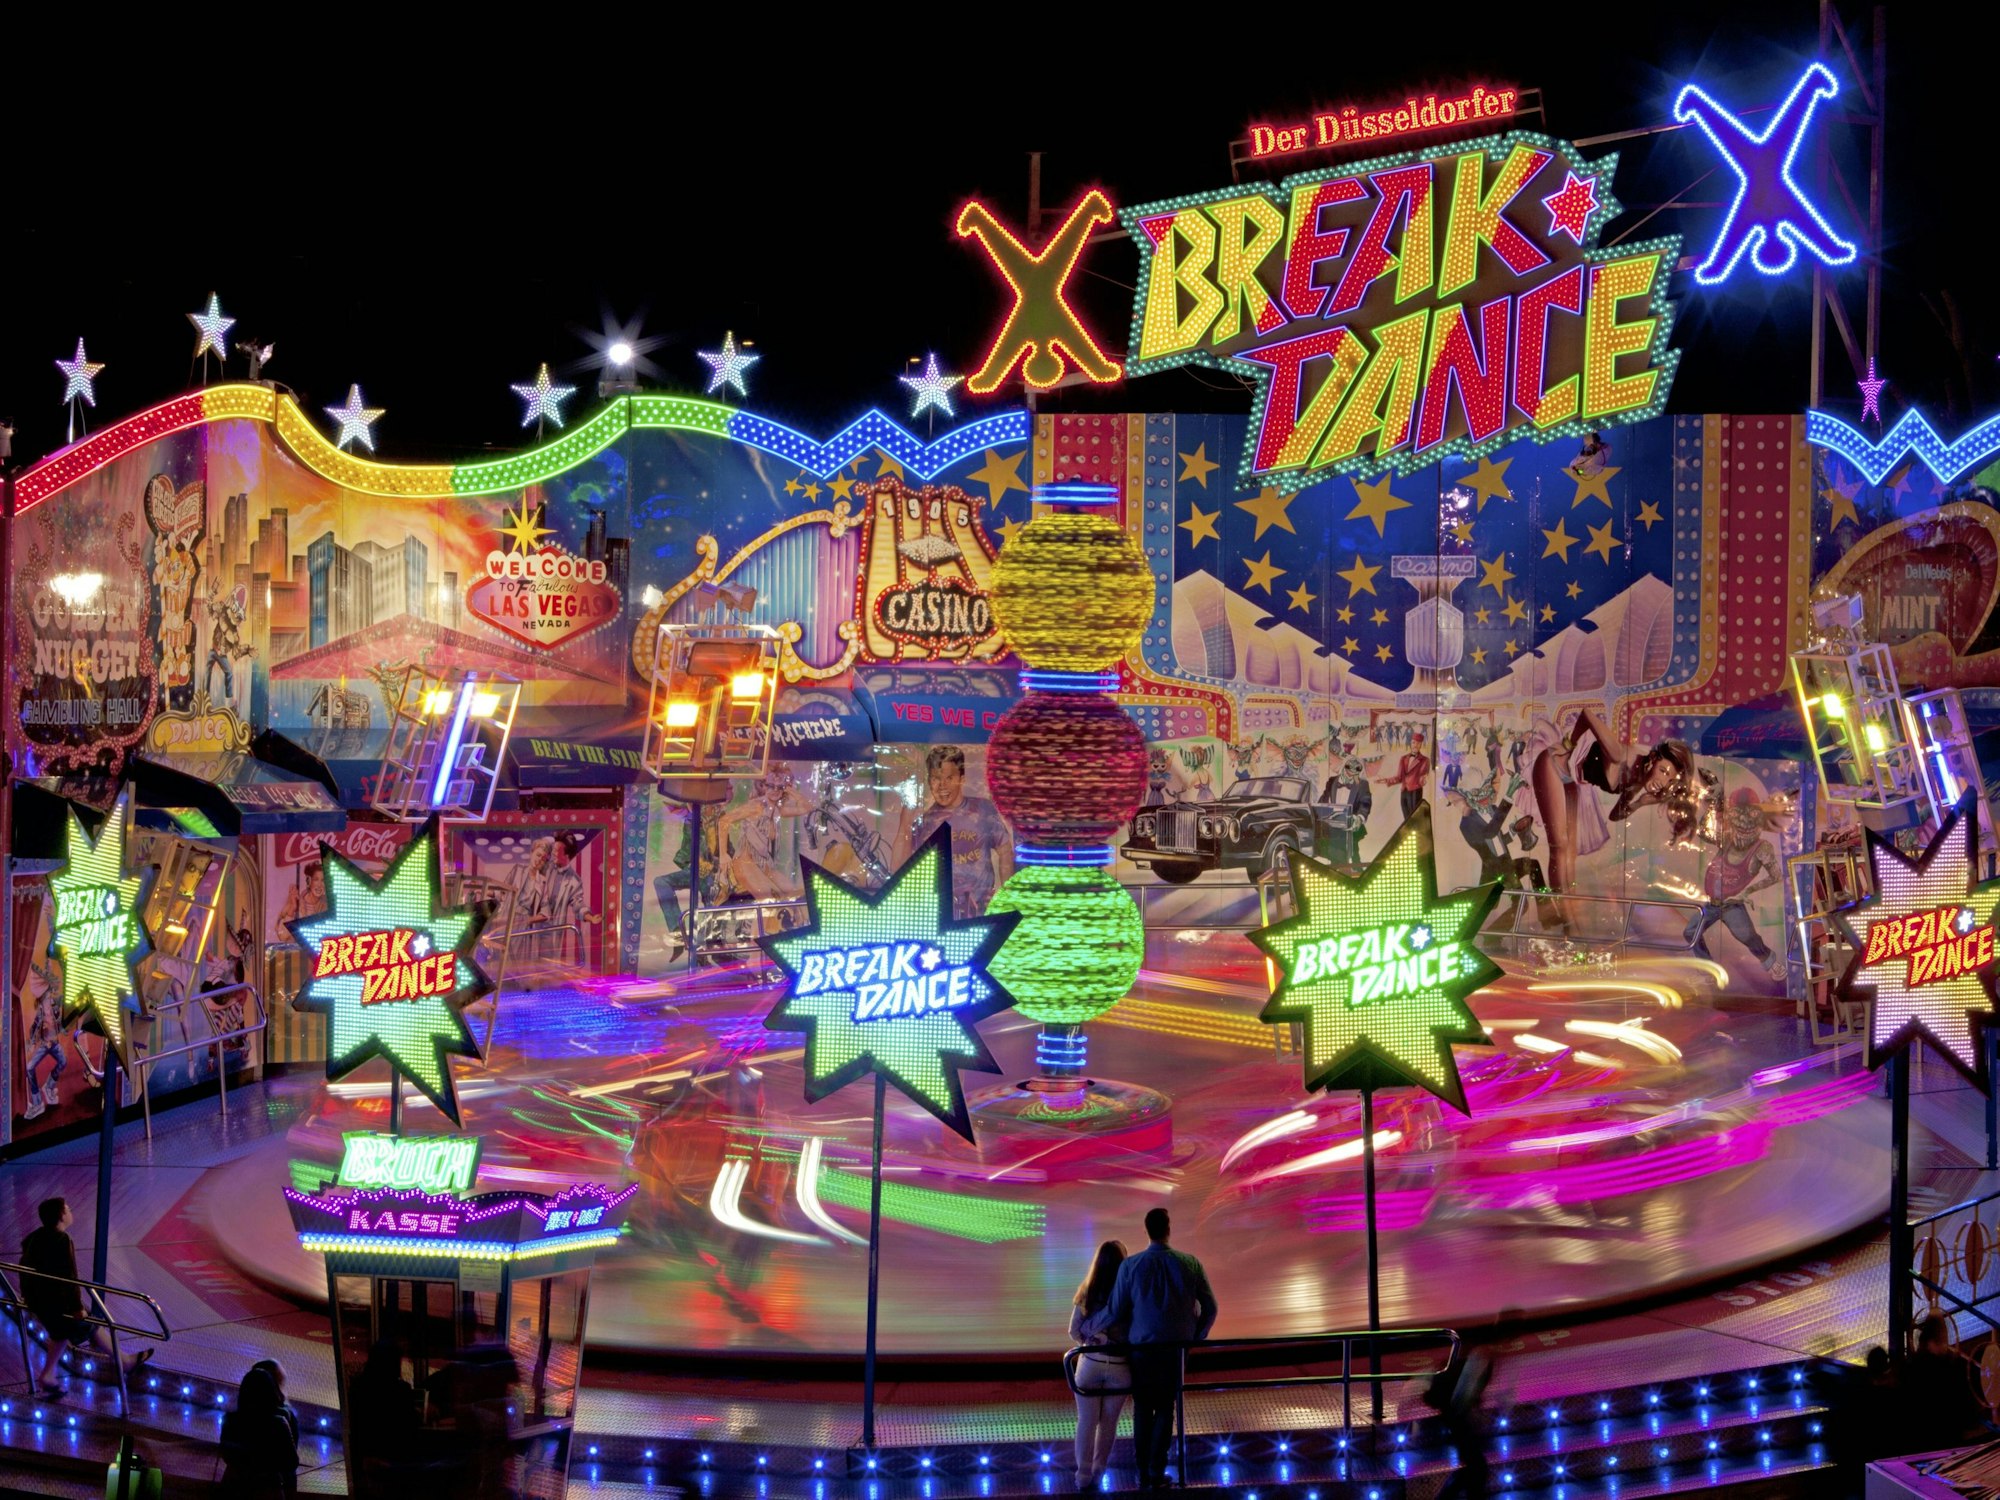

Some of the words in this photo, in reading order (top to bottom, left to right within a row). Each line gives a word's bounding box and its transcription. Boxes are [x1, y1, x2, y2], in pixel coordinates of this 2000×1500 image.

[1251, 125, 1308, 157] Der
[1316, 84, 1518, 146] Düsseldorfer
[1137, 144, 1554, 361] BREAK
[1232, 255, 1662, 475] DANCE
[490, 558, 604, 581] WELCOME
[1397, 558, 1474, 574] Casino
[489, 594, 530, 618] LAS
[538, 594, 602, 618] VEGAS
[499, 582, 515, 592] TO
[515, 579, 580, 598] Fabulous
[32, 590, 140, 632] GOLDEN
[522, 619, 571, 630] NEVADA
[887, 591, 989, 633] CASINO
[1881, 593, 1941, 629] MINT
[33, 638, 141, 685] NUGGET
[23, 698, 102, 726] GAMBLING
[106, 697, 141, 725] HALL
[772, 717, 847, 748] MACHINE
[891, 701, 935, 724] YES
[942, 707, 977, 727] WE
[529, 739, 573, 760] BEAT
[573, 744, 609, 765] THE
[284, 827, 400, 863] Coca-Cola
[55, 886, 108, 928] BREAK
[78, 913, 130, 956] DANCE
[315, 928, 417, 979] BREAK
[1291, 923, 1412, 986] BREAK
[1865, 907, 1959, 964] BREAK
[795, 943, 918, 996] BREAK
[1350, 942, 1461, 1006] DANCE
[1909, 926, 1994, 986] DANCE
[361, 952, 456, 1005] DANCE
[852, 965, 972, 1023] DANCE
[344, 1136, 478, 1189] BRUCH
[349, 1209, 460, 1234] KASSE
[1712, 1260, 1836, 1307] STOP
